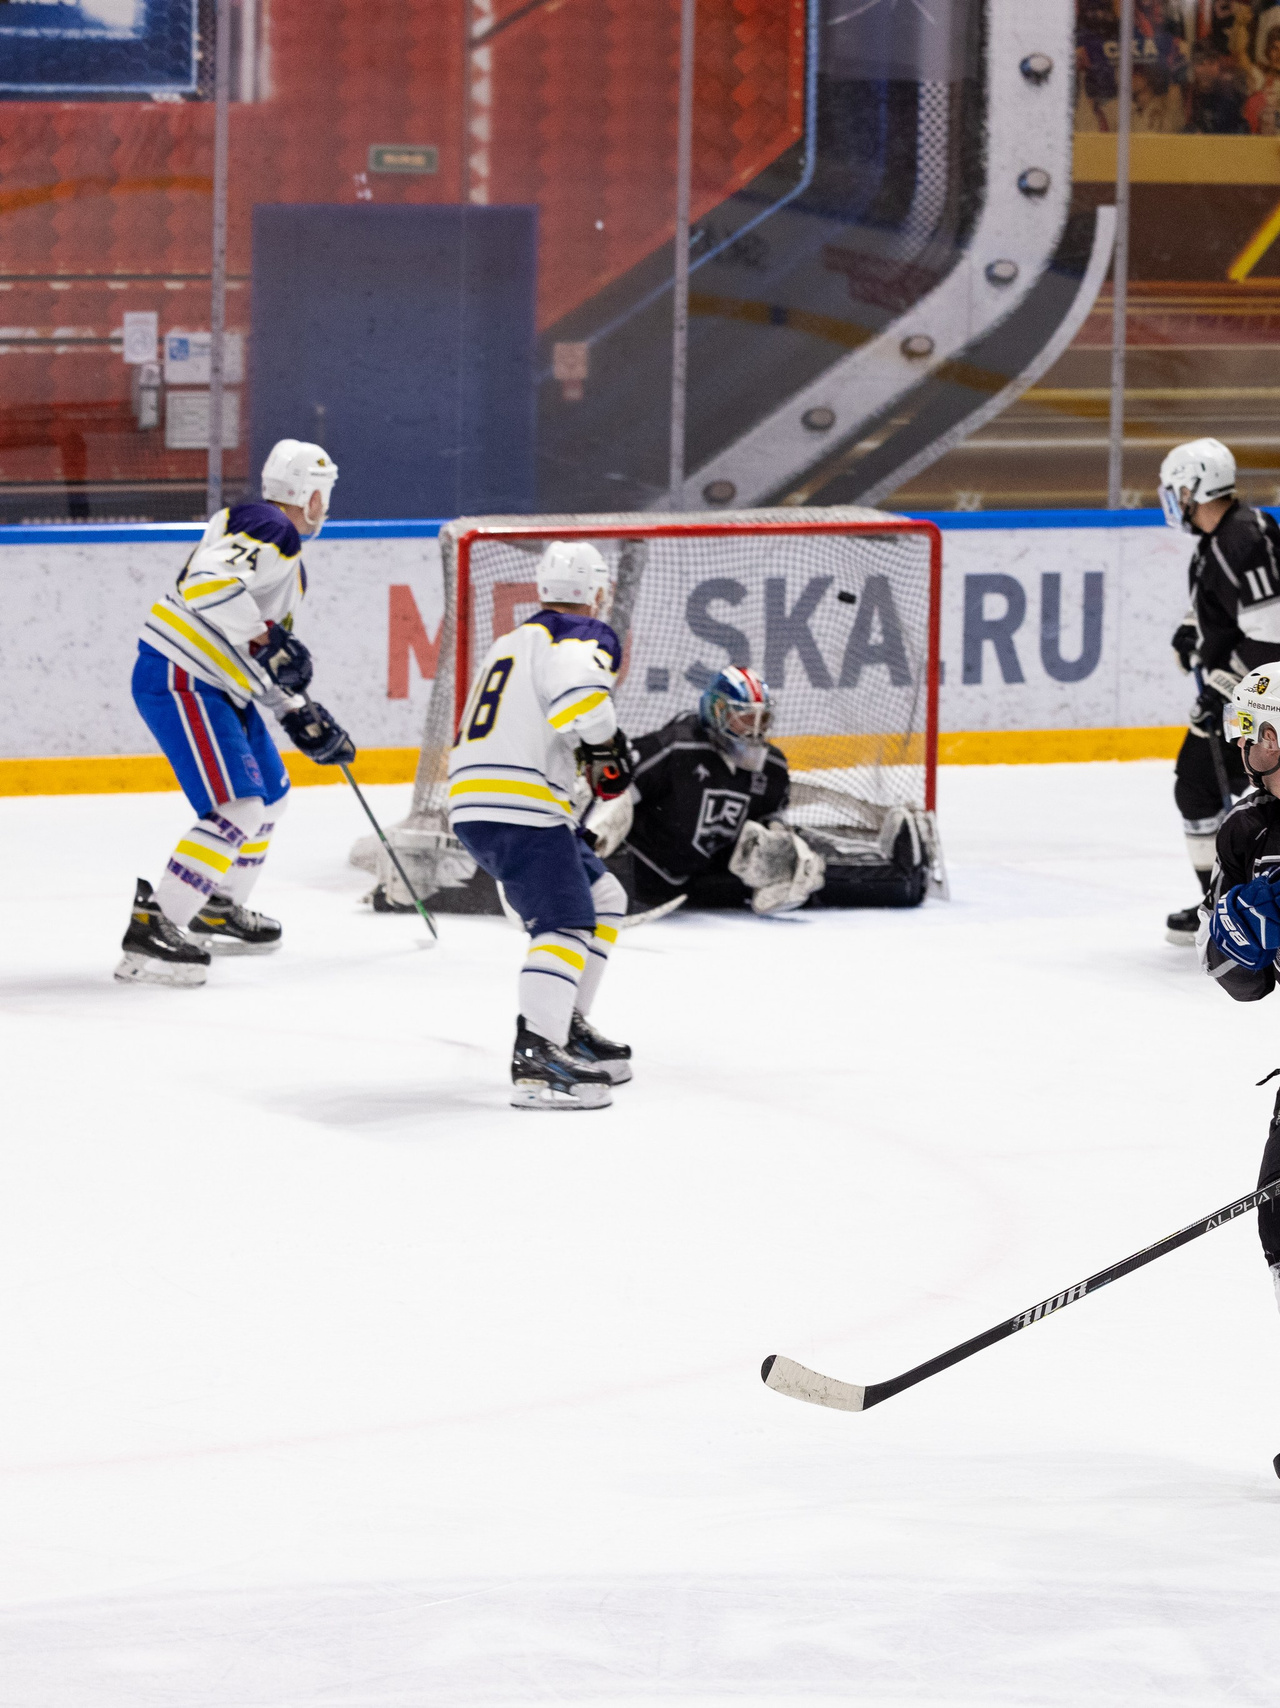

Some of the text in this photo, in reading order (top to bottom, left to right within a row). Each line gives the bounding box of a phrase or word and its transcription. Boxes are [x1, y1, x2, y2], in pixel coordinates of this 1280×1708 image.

[1245, 565, 1275, 601] 11
[387, 572, 1104, 700] M.SKA.RU
[1205, 1190, 1271, 1232] ALPHA
